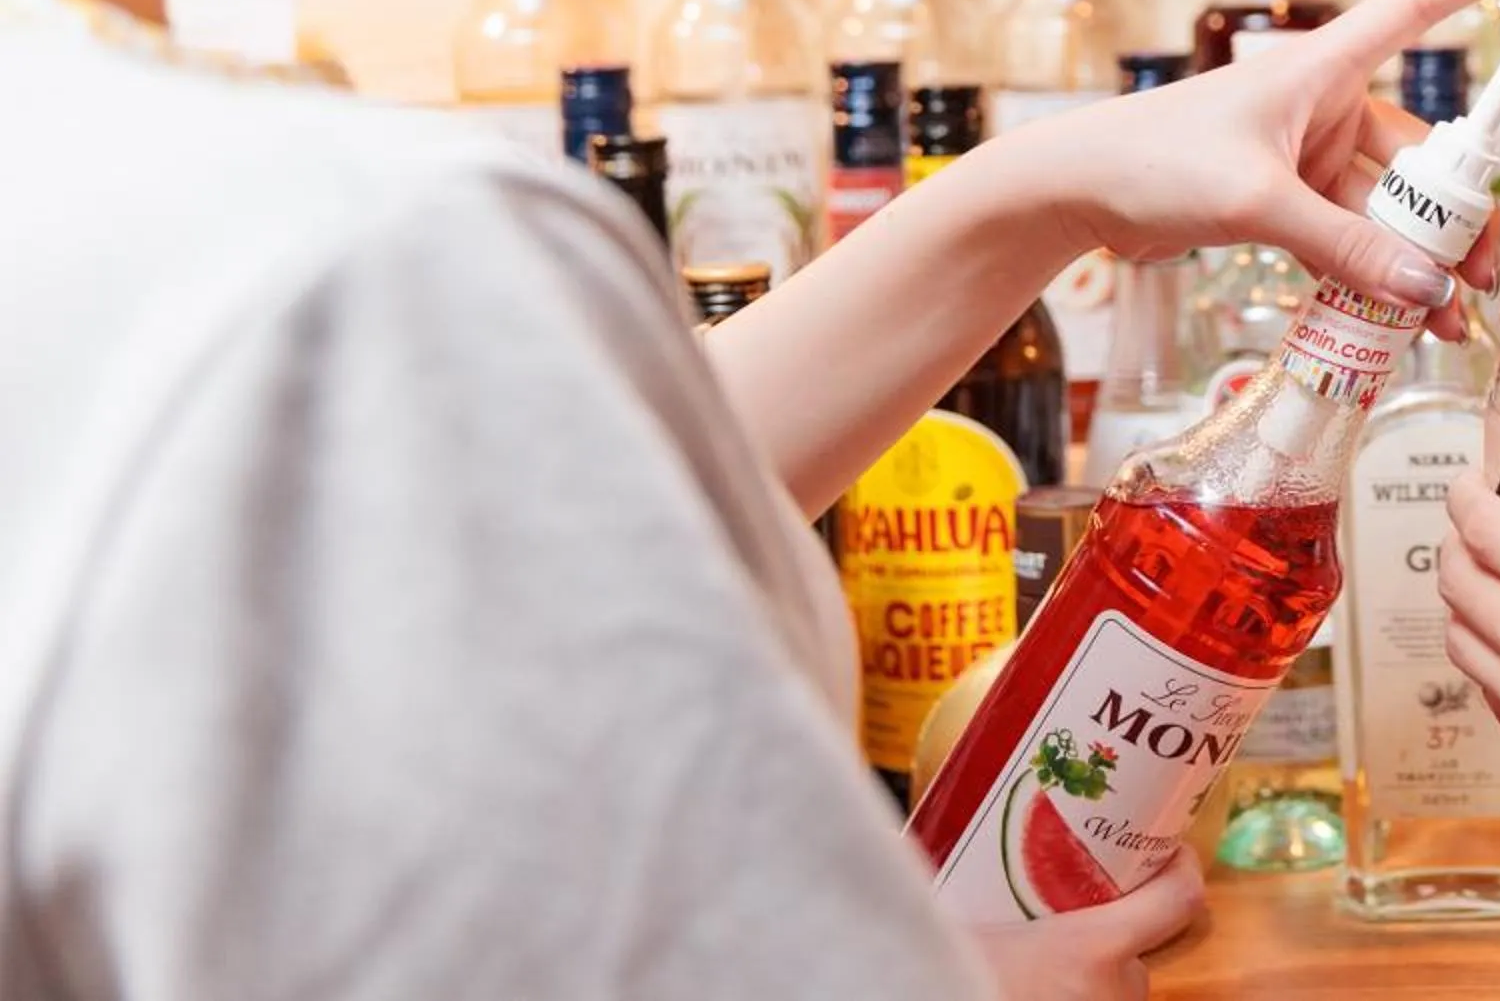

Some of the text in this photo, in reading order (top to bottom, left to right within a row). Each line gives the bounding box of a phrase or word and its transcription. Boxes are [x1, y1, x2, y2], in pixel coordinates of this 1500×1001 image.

[1295, 324, 1391, 366] onin.com
[1372, 482, 1450, 502] WILKI
[1406, 545, 1442, 573] GI
[885, 595, 1006, 639] COFFEE
